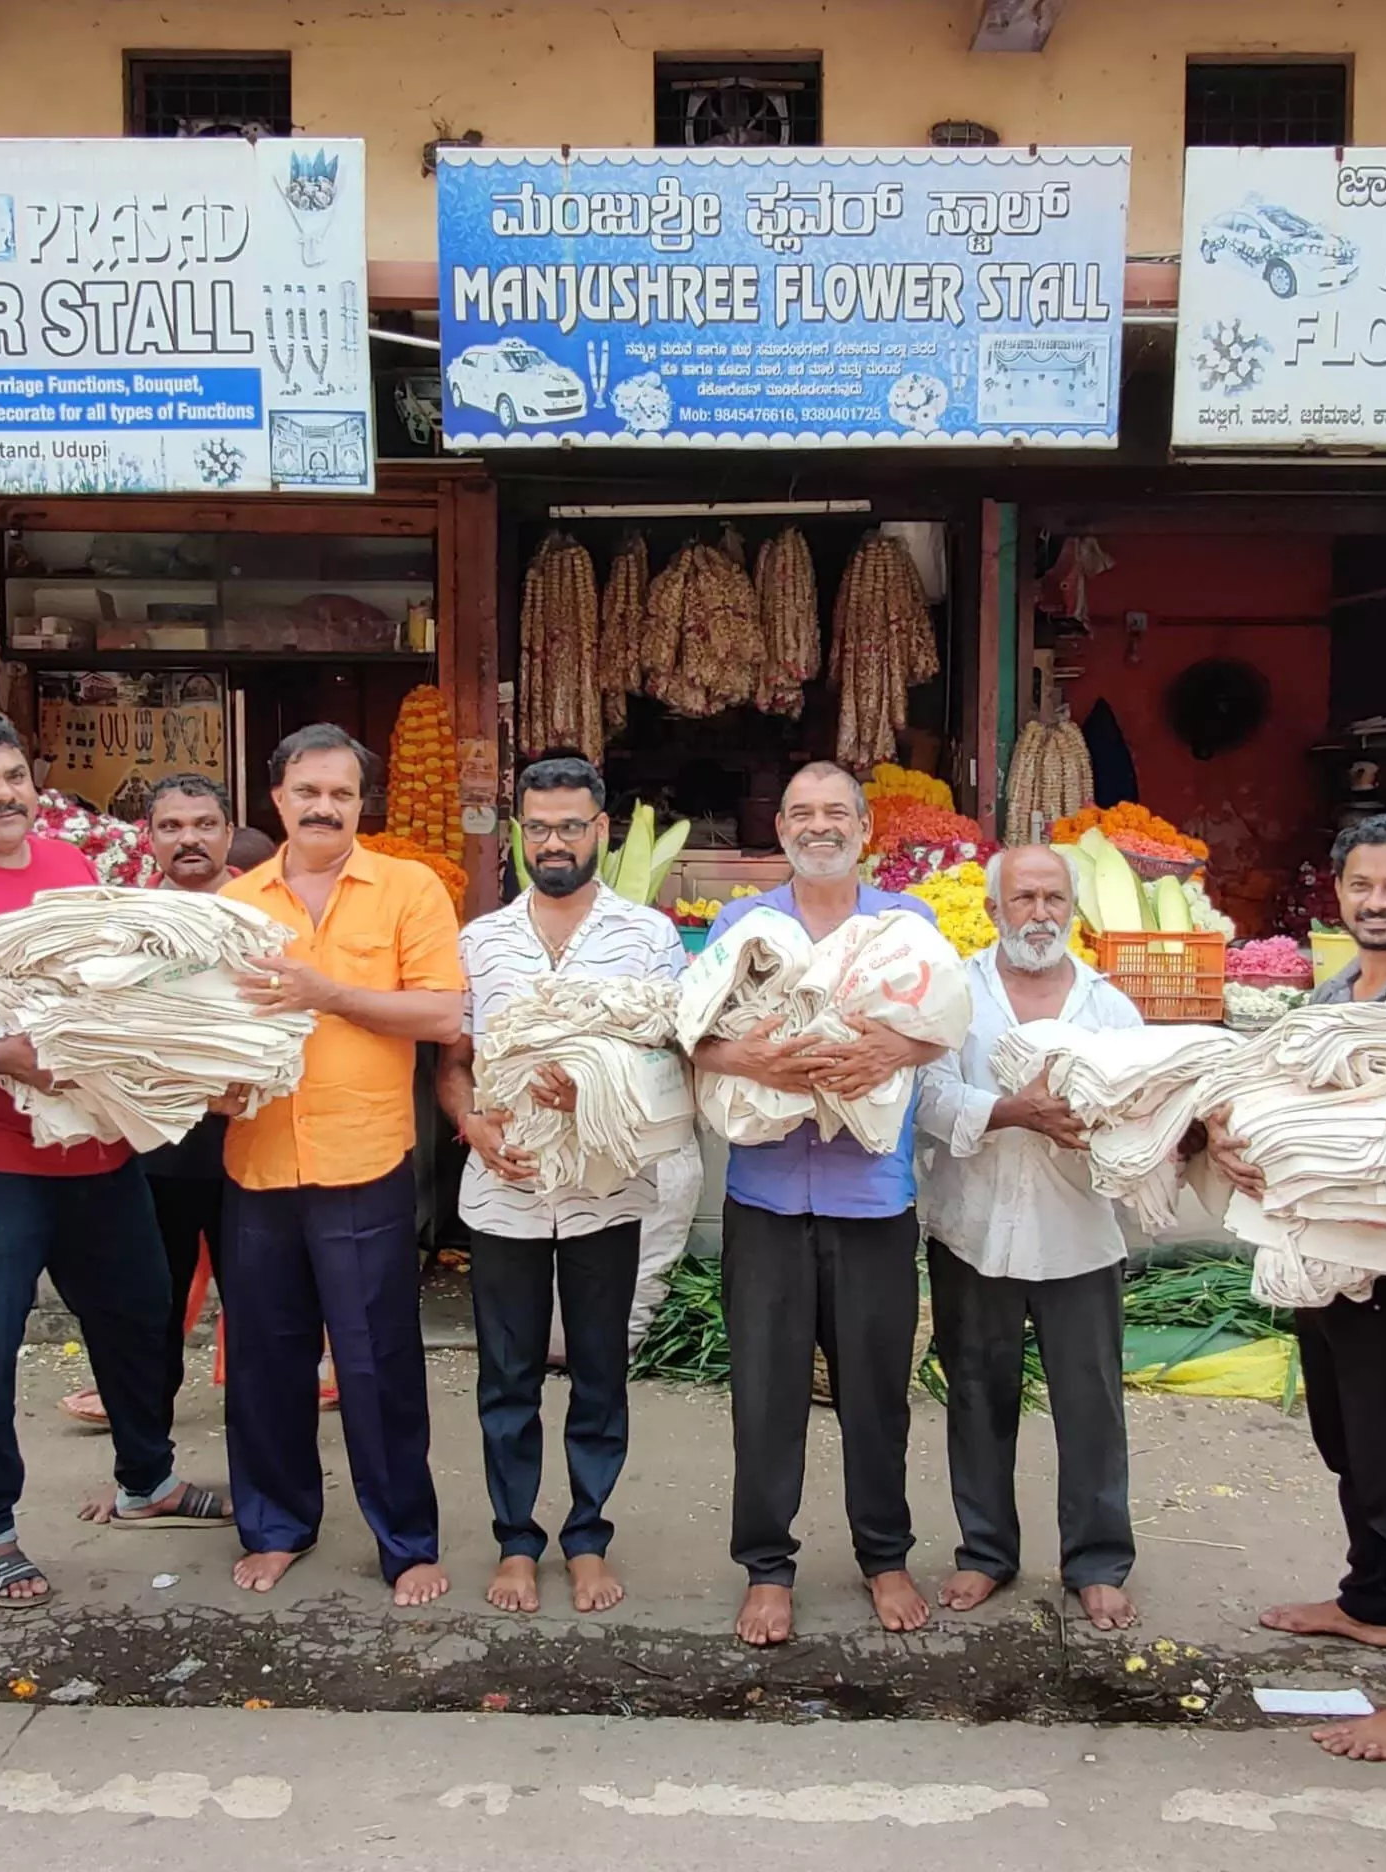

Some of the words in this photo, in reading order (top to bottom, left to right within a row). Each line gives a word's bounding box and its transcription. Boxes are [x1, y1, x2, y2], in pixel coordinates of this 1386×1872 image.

[25, 193, 252, 273] PRASAD
[492, 176, 721, 252] ಮಂಜುಶ್ರೀ
[746, 180, 904, 254] ಫ್ಲವರ್
[927, 181, 1071, 254] ಸ್ಟಾಲ್
[41, 279, 257, 357] STALL
[453, 262, 761, 334] MANJUSHREE
[774, 262, 967, 326] FLOWER
[977, 261, 1111, 326] STALL
[47, 375, 131, 397] Functions,
[133, 375, 204, 397] Bouquet,
[59, 403, 83, 421] for
[86, 402, 106, 421] all
[111, 403, 153, 424] types
[157, 402, 174, 420] of
[177, 402, 255, 420] Functions
[679, 407, 712, 421] Mob:
[714, 407, 799, 423] 9845476616,
[801, 407, 882, 422] 9380401725
[51, 440, 108, 464] Udupi
